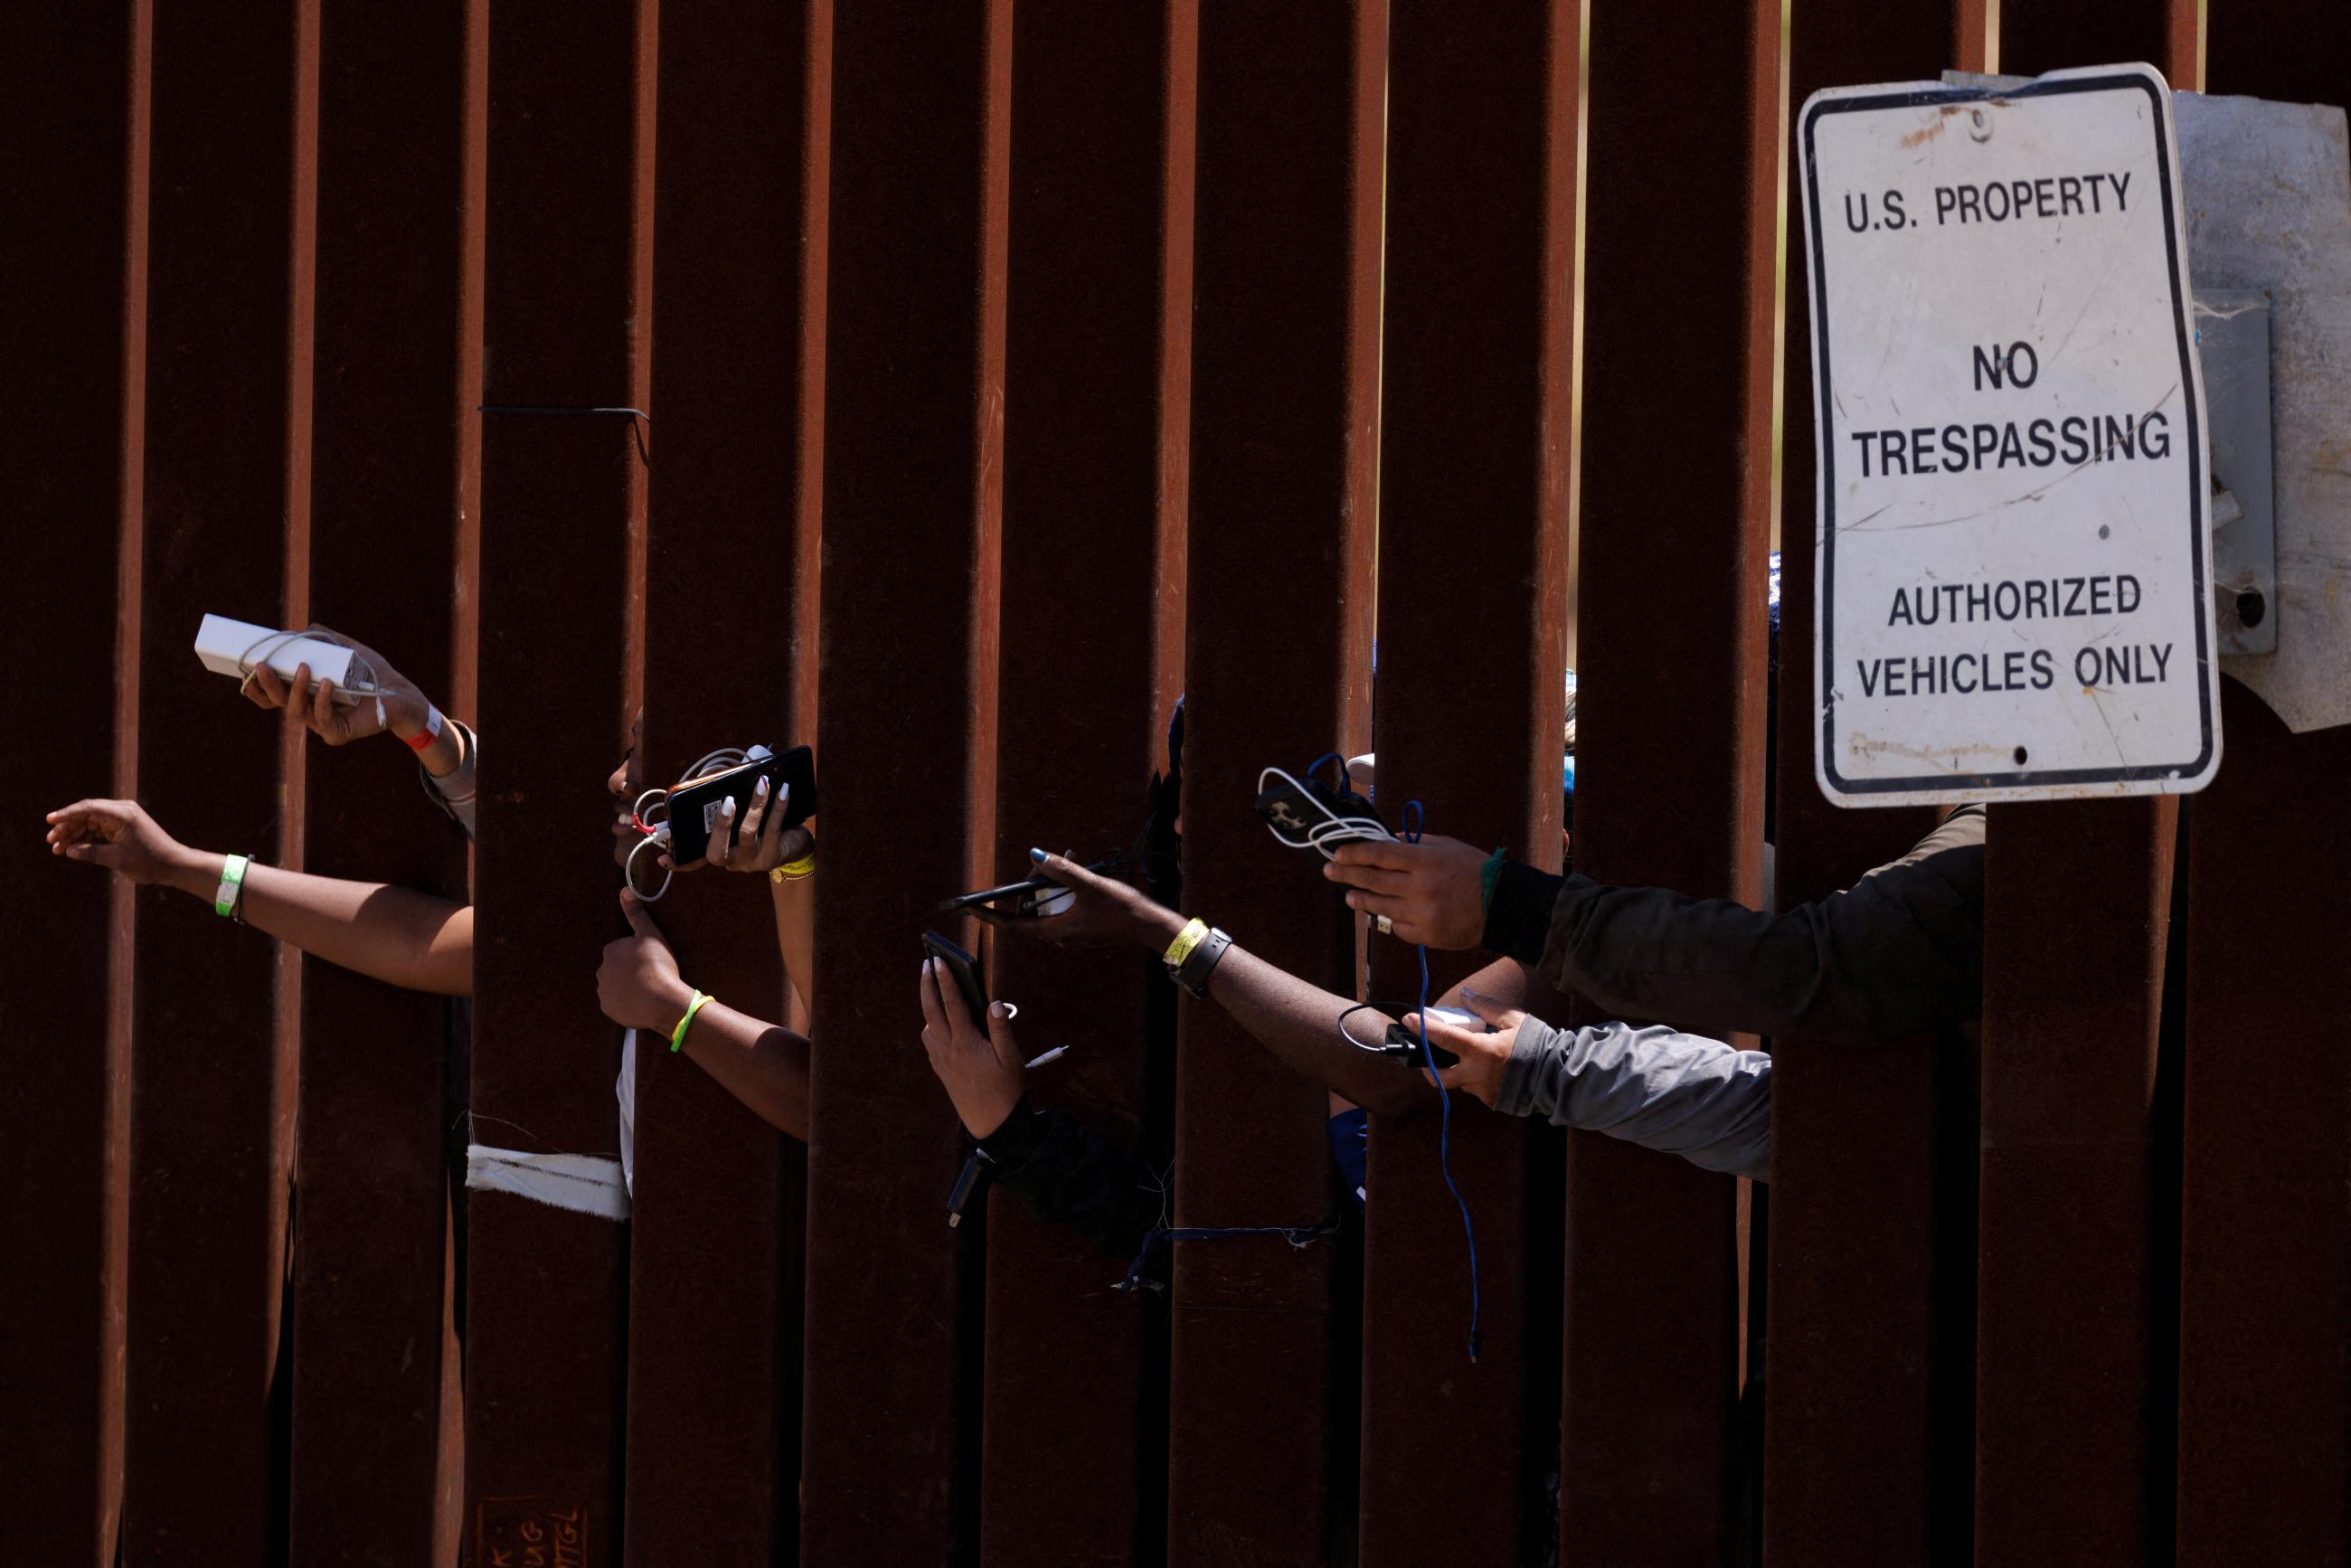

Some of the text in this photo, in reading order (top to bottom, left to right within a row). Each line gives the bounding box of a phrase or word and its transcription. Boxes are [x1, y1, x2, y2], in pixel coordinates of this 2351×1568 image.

[1845, 172, 2131, 233] U.S. PROPERTY
[1973, 341, 2038, 392] NO
[1851, 411, 2170, 477] TRESPASSING
[1887, 574, 2141, 627] AUTHORIZED
[1856, 643, 2173, 697] VEHICLES ONLY
